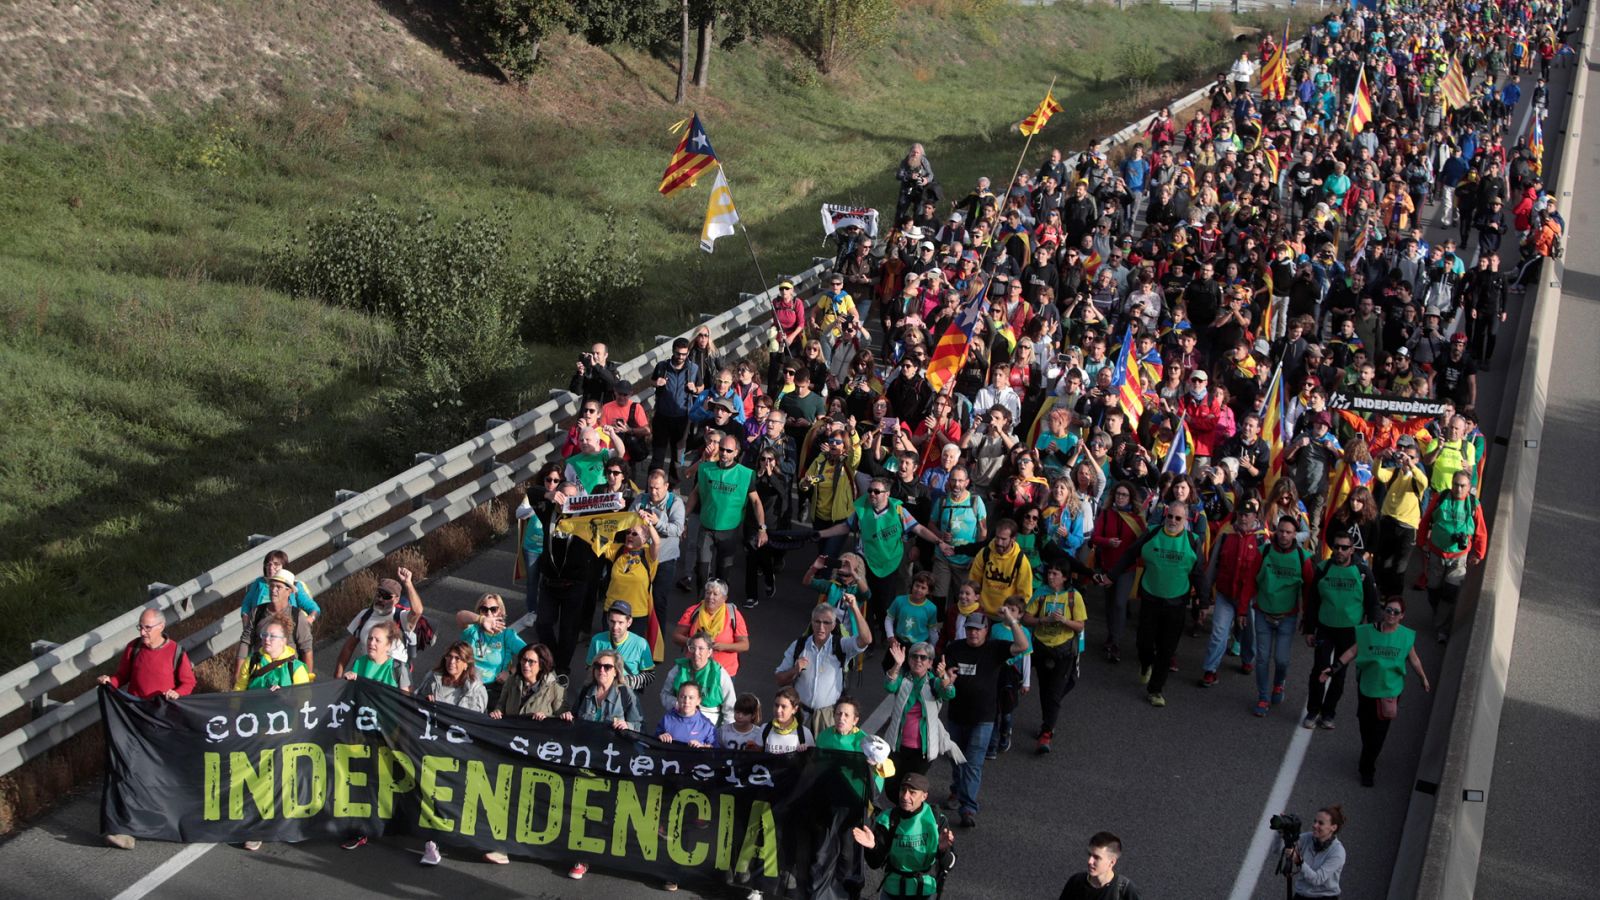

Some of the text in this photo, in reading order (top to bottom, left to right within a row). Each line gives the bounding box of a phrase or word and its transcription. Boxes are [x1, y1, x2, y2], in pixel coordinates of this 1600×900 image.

[1353, 397, 1445, 414] INDEPENDÈNCIA
[569, 494, 616, 505] LLIBERTAT
[205, 700, 776, 788] contra la sentencia
[203, 742, 779, 878] INDEPENDÈNCIA
